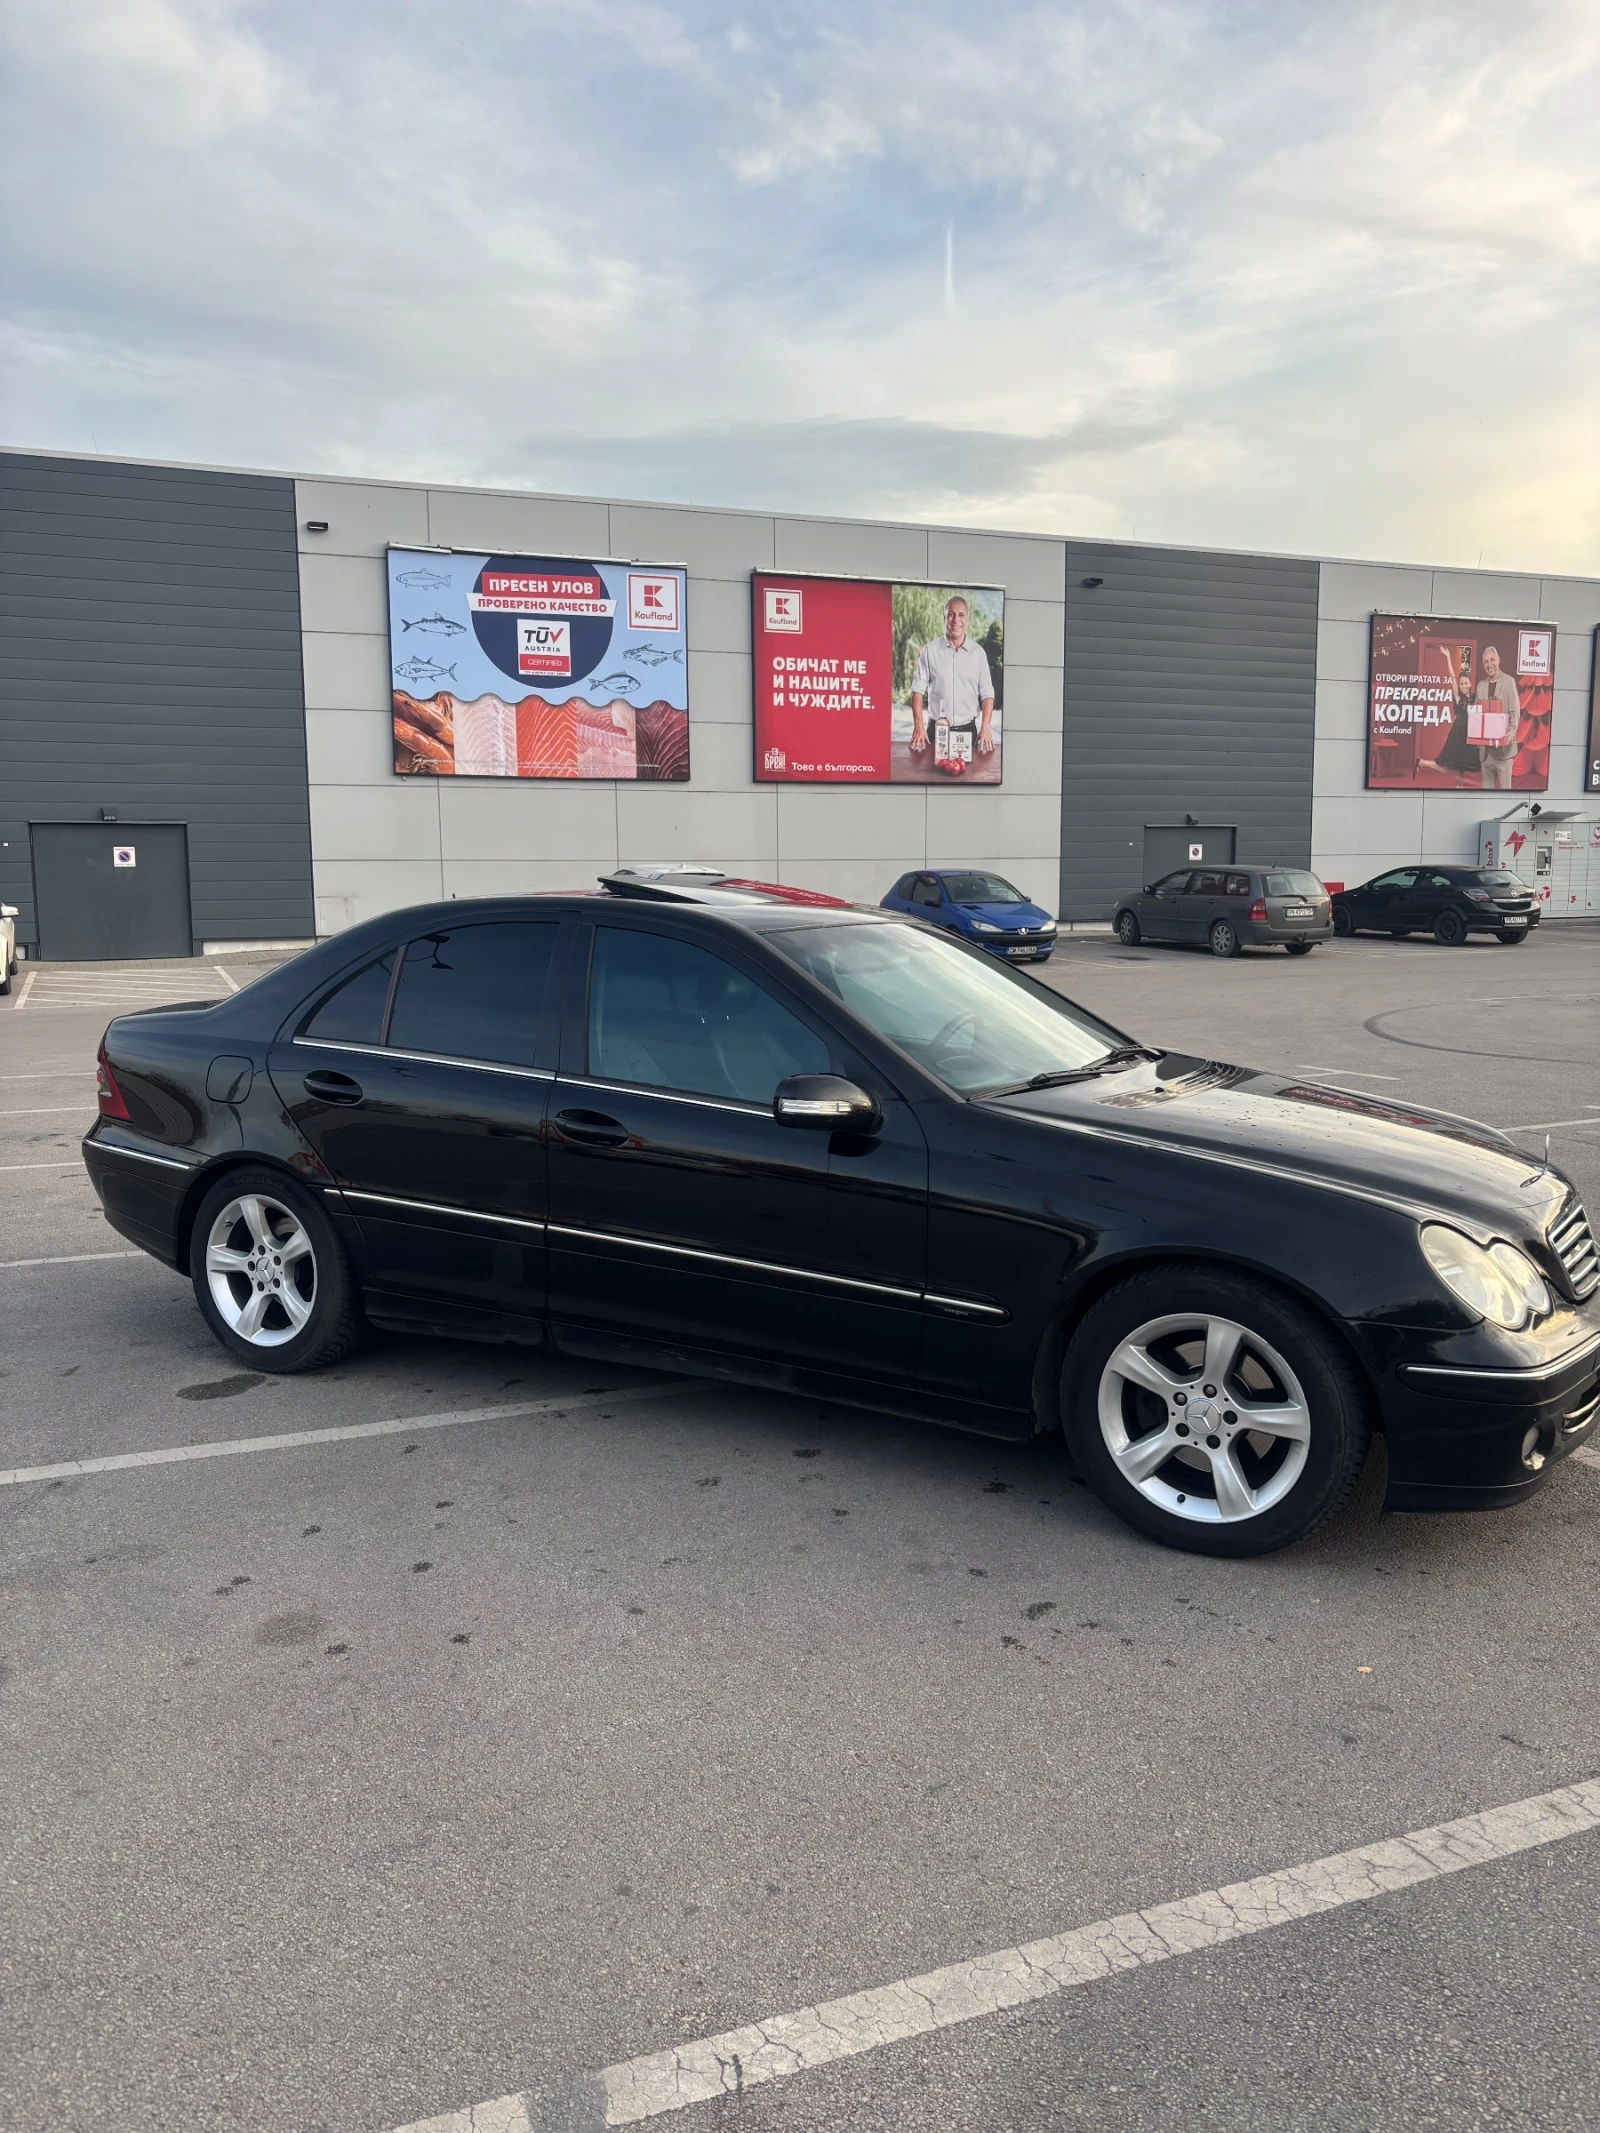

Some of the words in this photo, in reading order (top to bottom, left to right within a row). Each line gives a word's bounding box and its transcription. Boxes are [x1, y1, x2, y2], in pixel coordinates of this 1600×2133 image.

[489, 578, 548, 593] ПРЕСЕН
[552, 580, 594, 595] УЛОВ
[477, 598, 547, 611] ПРОВЕРЕНО
[549, 600, 607, 613] КАЧЕСТВО
[634, 610, 673, 622] Kaufland
[768, 617, 797, 626] Kaufland
[524, 645, 561, 653] AUSTRIA
[527, 658, 563, 667] CERTIFIED
[772, 656, 839, 673] ОБИЧАТ
[844, 660, 867, 675] МЕ
[1521, 659, 1546, 668] Kaufland
[773, 675, 784, 689] И
[789, 675, 864, 694] НАШИТЕ,
[1375, 673, 1407, 683] ОТВОРИ
[1409, 675, 1441, 684] ВРАТАТА
[1442, 676, 1453, 684] ЗА
[1374, 686, 1453, 702] ПРЕКРАСНА
[773, 692, 784, 706] И
[789, 693, 875, 711] ЧУЖДИТЕ.
[1374, 703, 1452, 727] КОЛЕДА
[1379, 725, 1412, 735] Kaufland
[791, 762, 814, 771] Това
[824, 763, 875, 774] българско.
